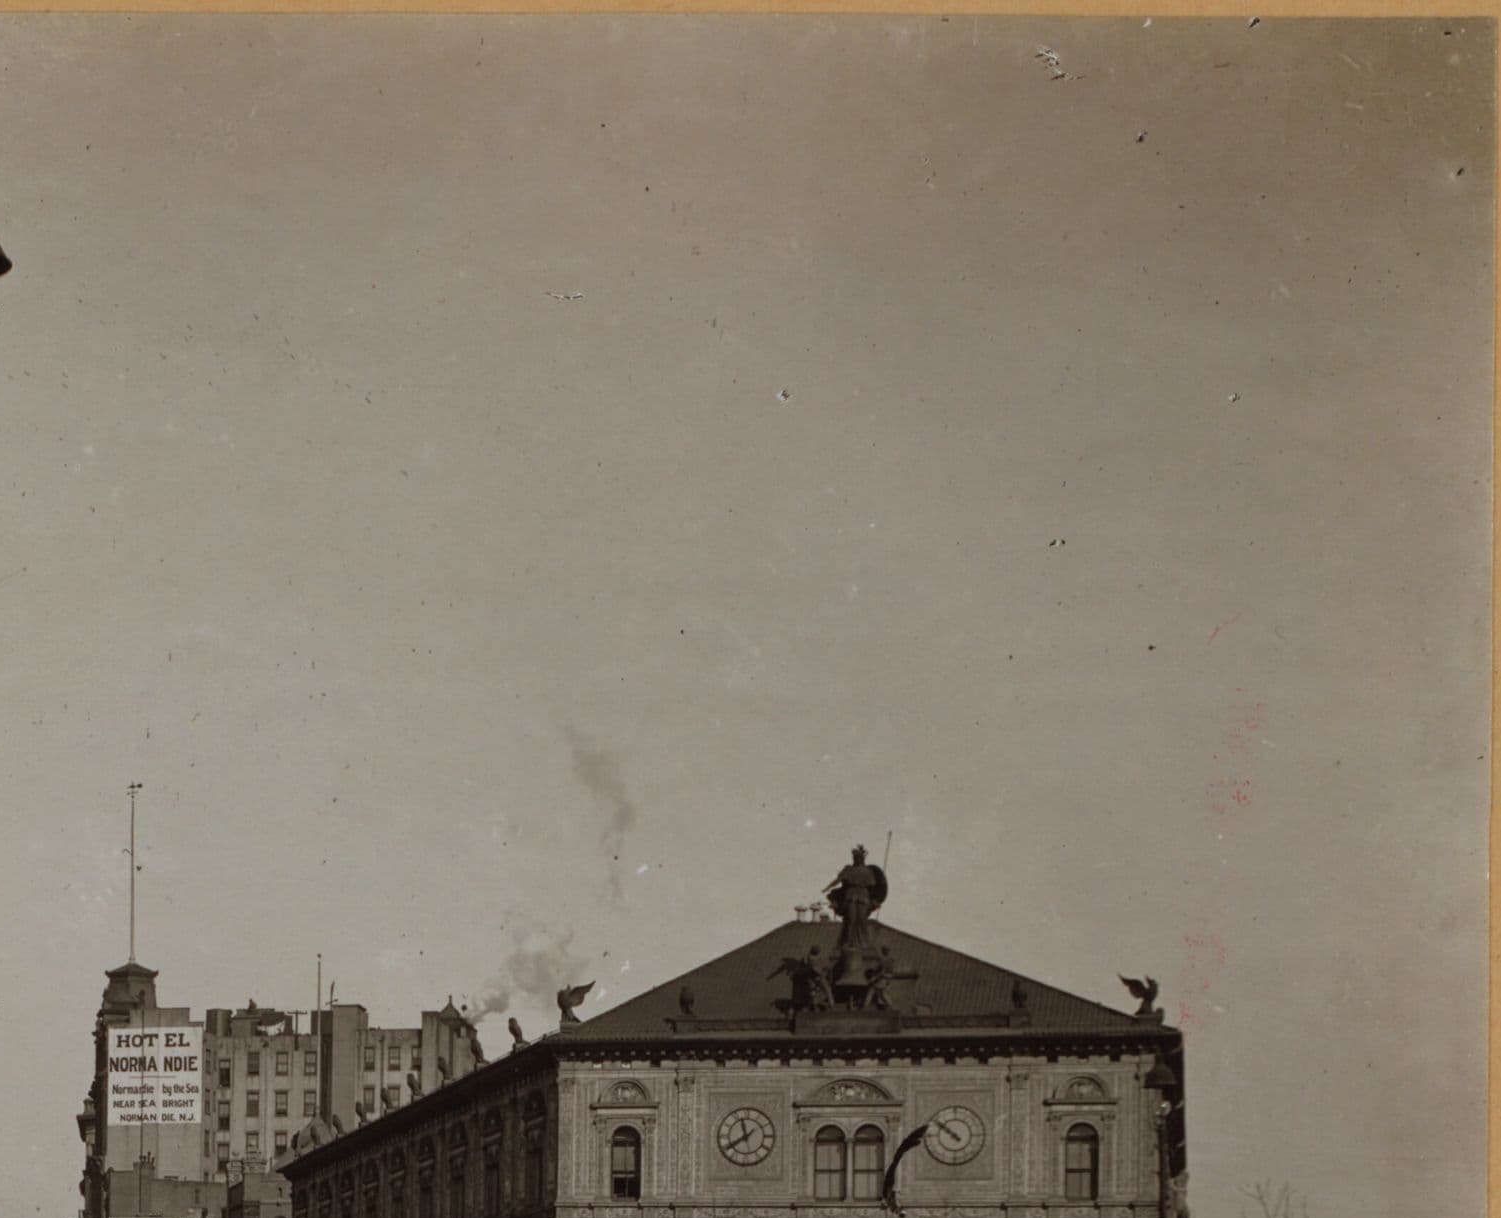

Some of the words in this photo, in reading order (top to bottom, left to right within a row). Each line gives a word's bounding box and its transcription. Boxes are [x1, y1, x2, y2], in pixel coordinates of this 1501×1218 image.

[117, 1033, 191, 1048] HOTEL
[109, 1056, 199, 1072] NORMANDIE
[162, 1083, 173, 1096] by
[174, 1083, 185, 1094] the
[186, 1083, 200, 1094] Sea
[113, 1100, 136, 1109] NEAR
[162, 1099, 195, 1108] BRIGHT
